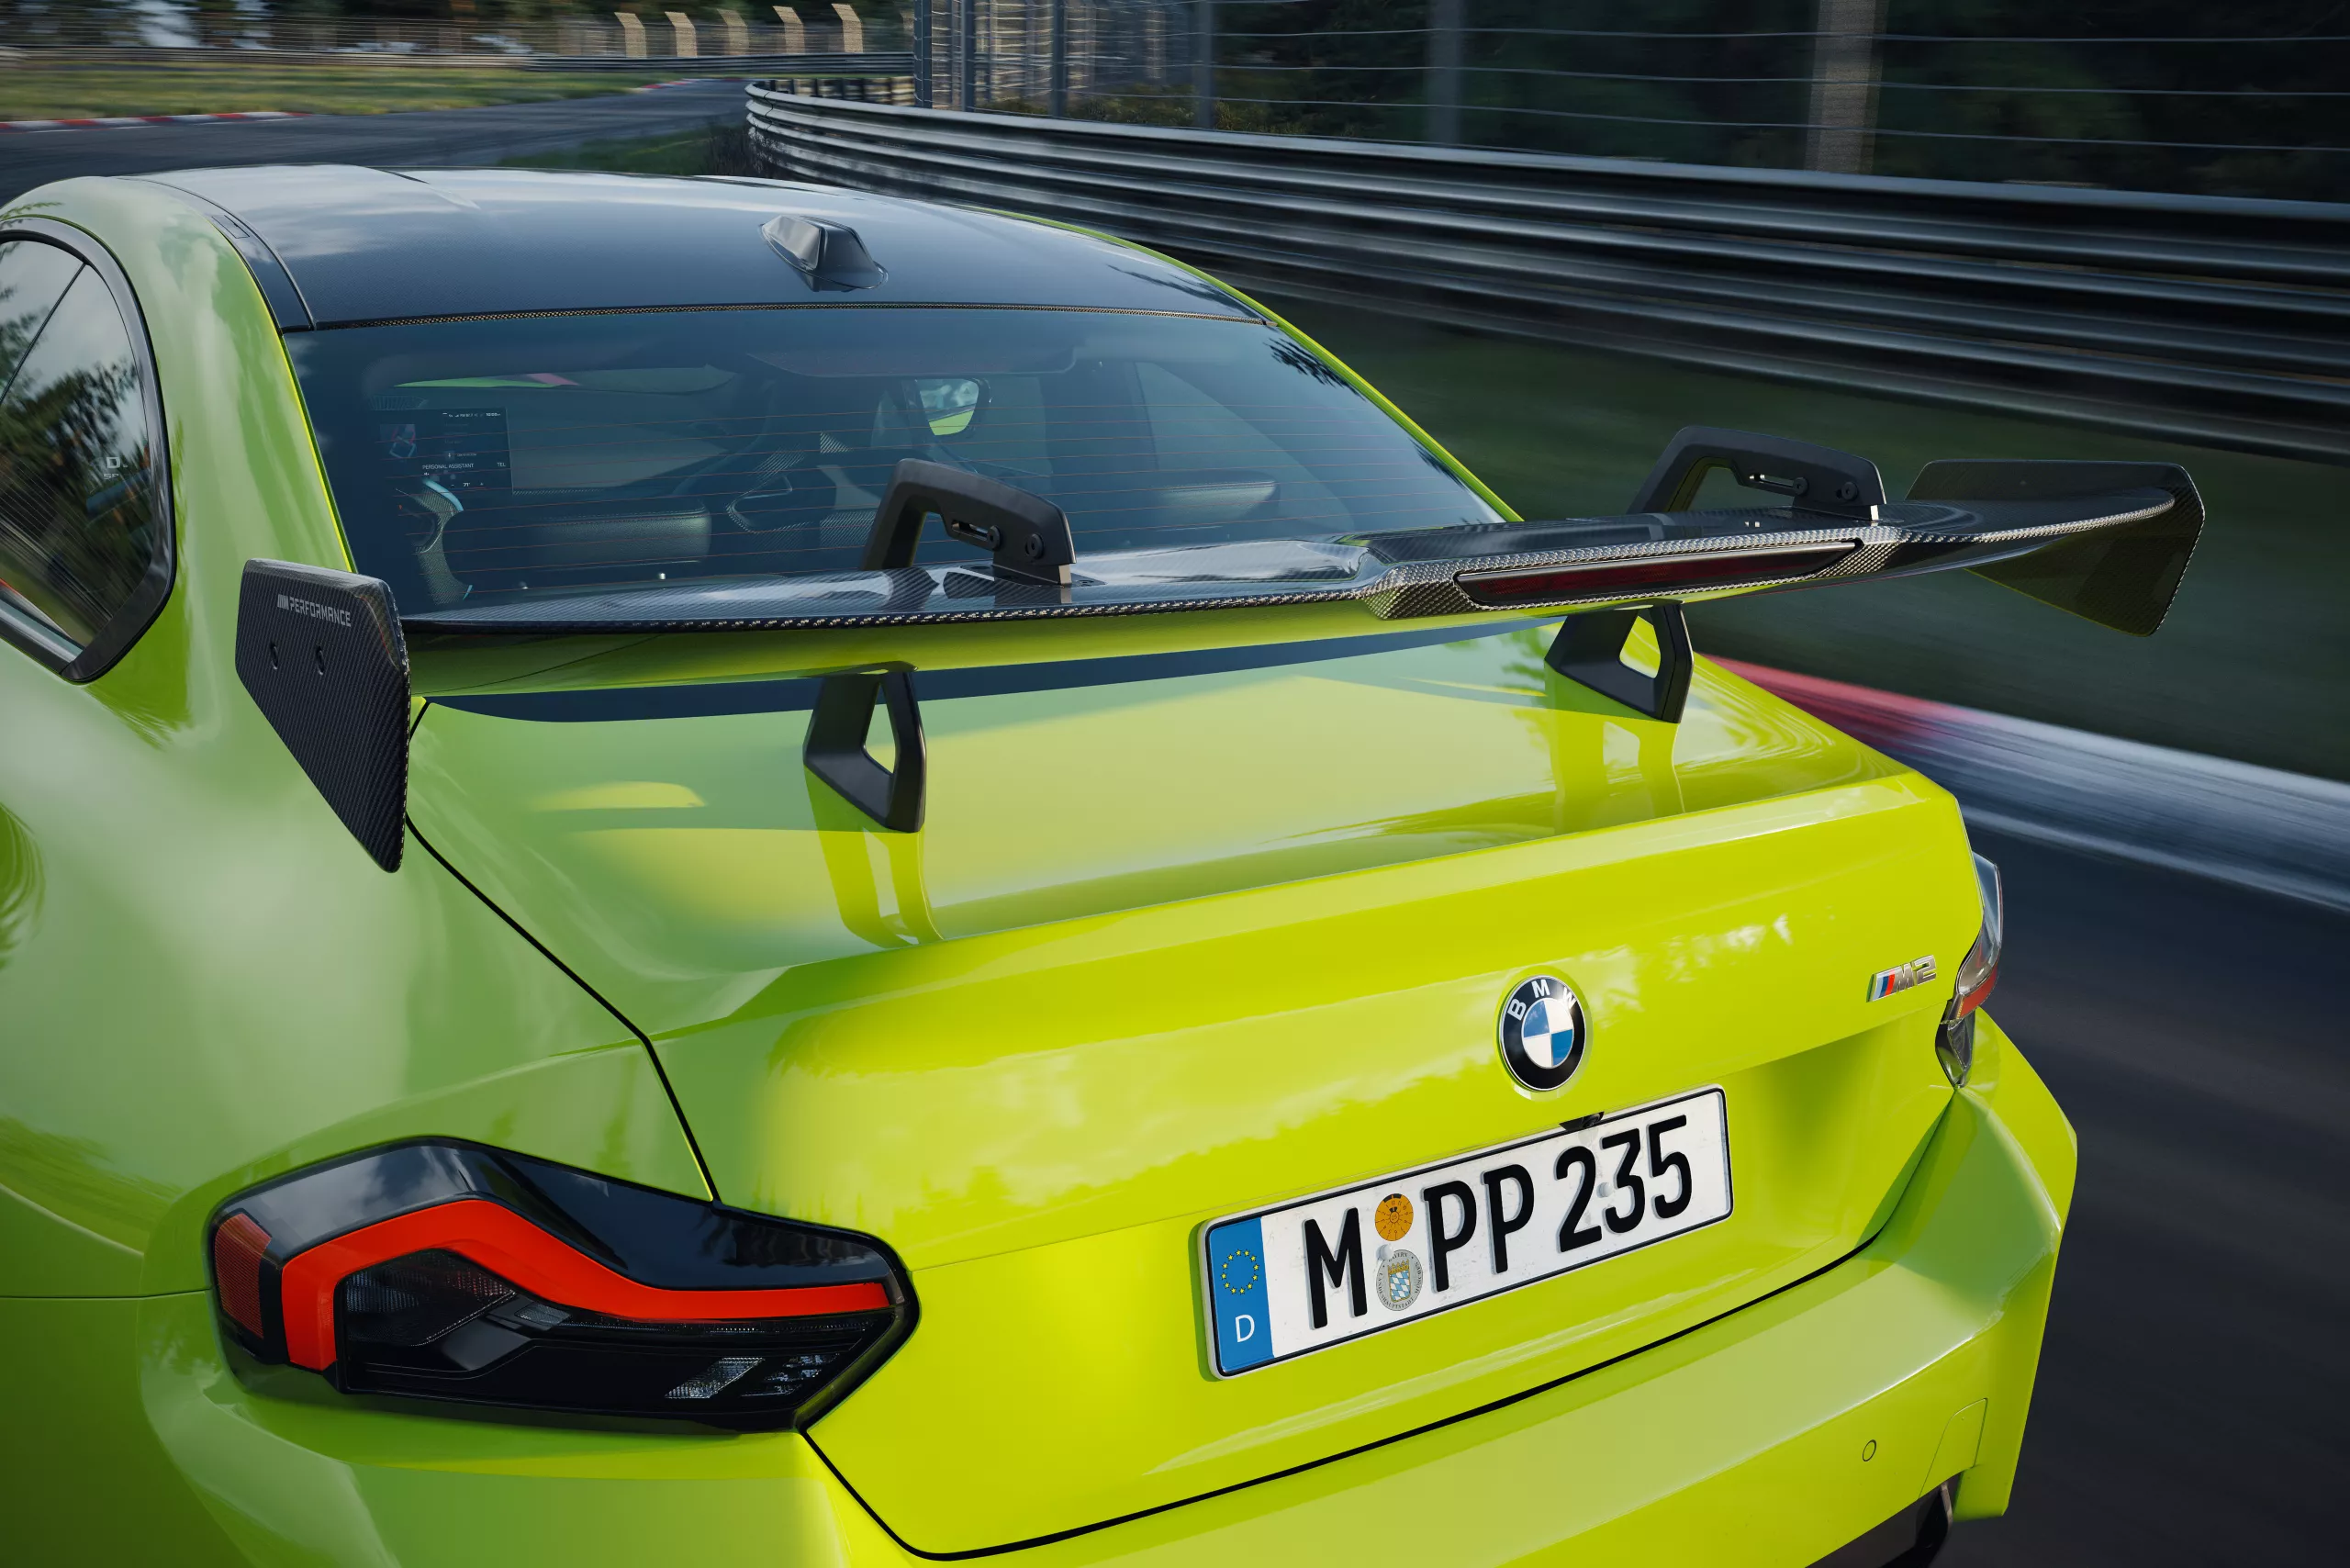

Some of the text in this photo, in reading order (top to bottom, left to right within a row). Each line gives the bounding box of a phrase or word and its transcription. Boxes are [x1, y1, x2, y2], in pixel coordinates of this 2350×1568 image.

[290, 597, 351, 627] PERFORMANCE
[1887, 954, 1936, 994] M2
[1506, 979, 1577, 1021] BMW
[1304, 1114, 1693, 1329] M PP 235
[1235, 1314, 1255, 1343] D
